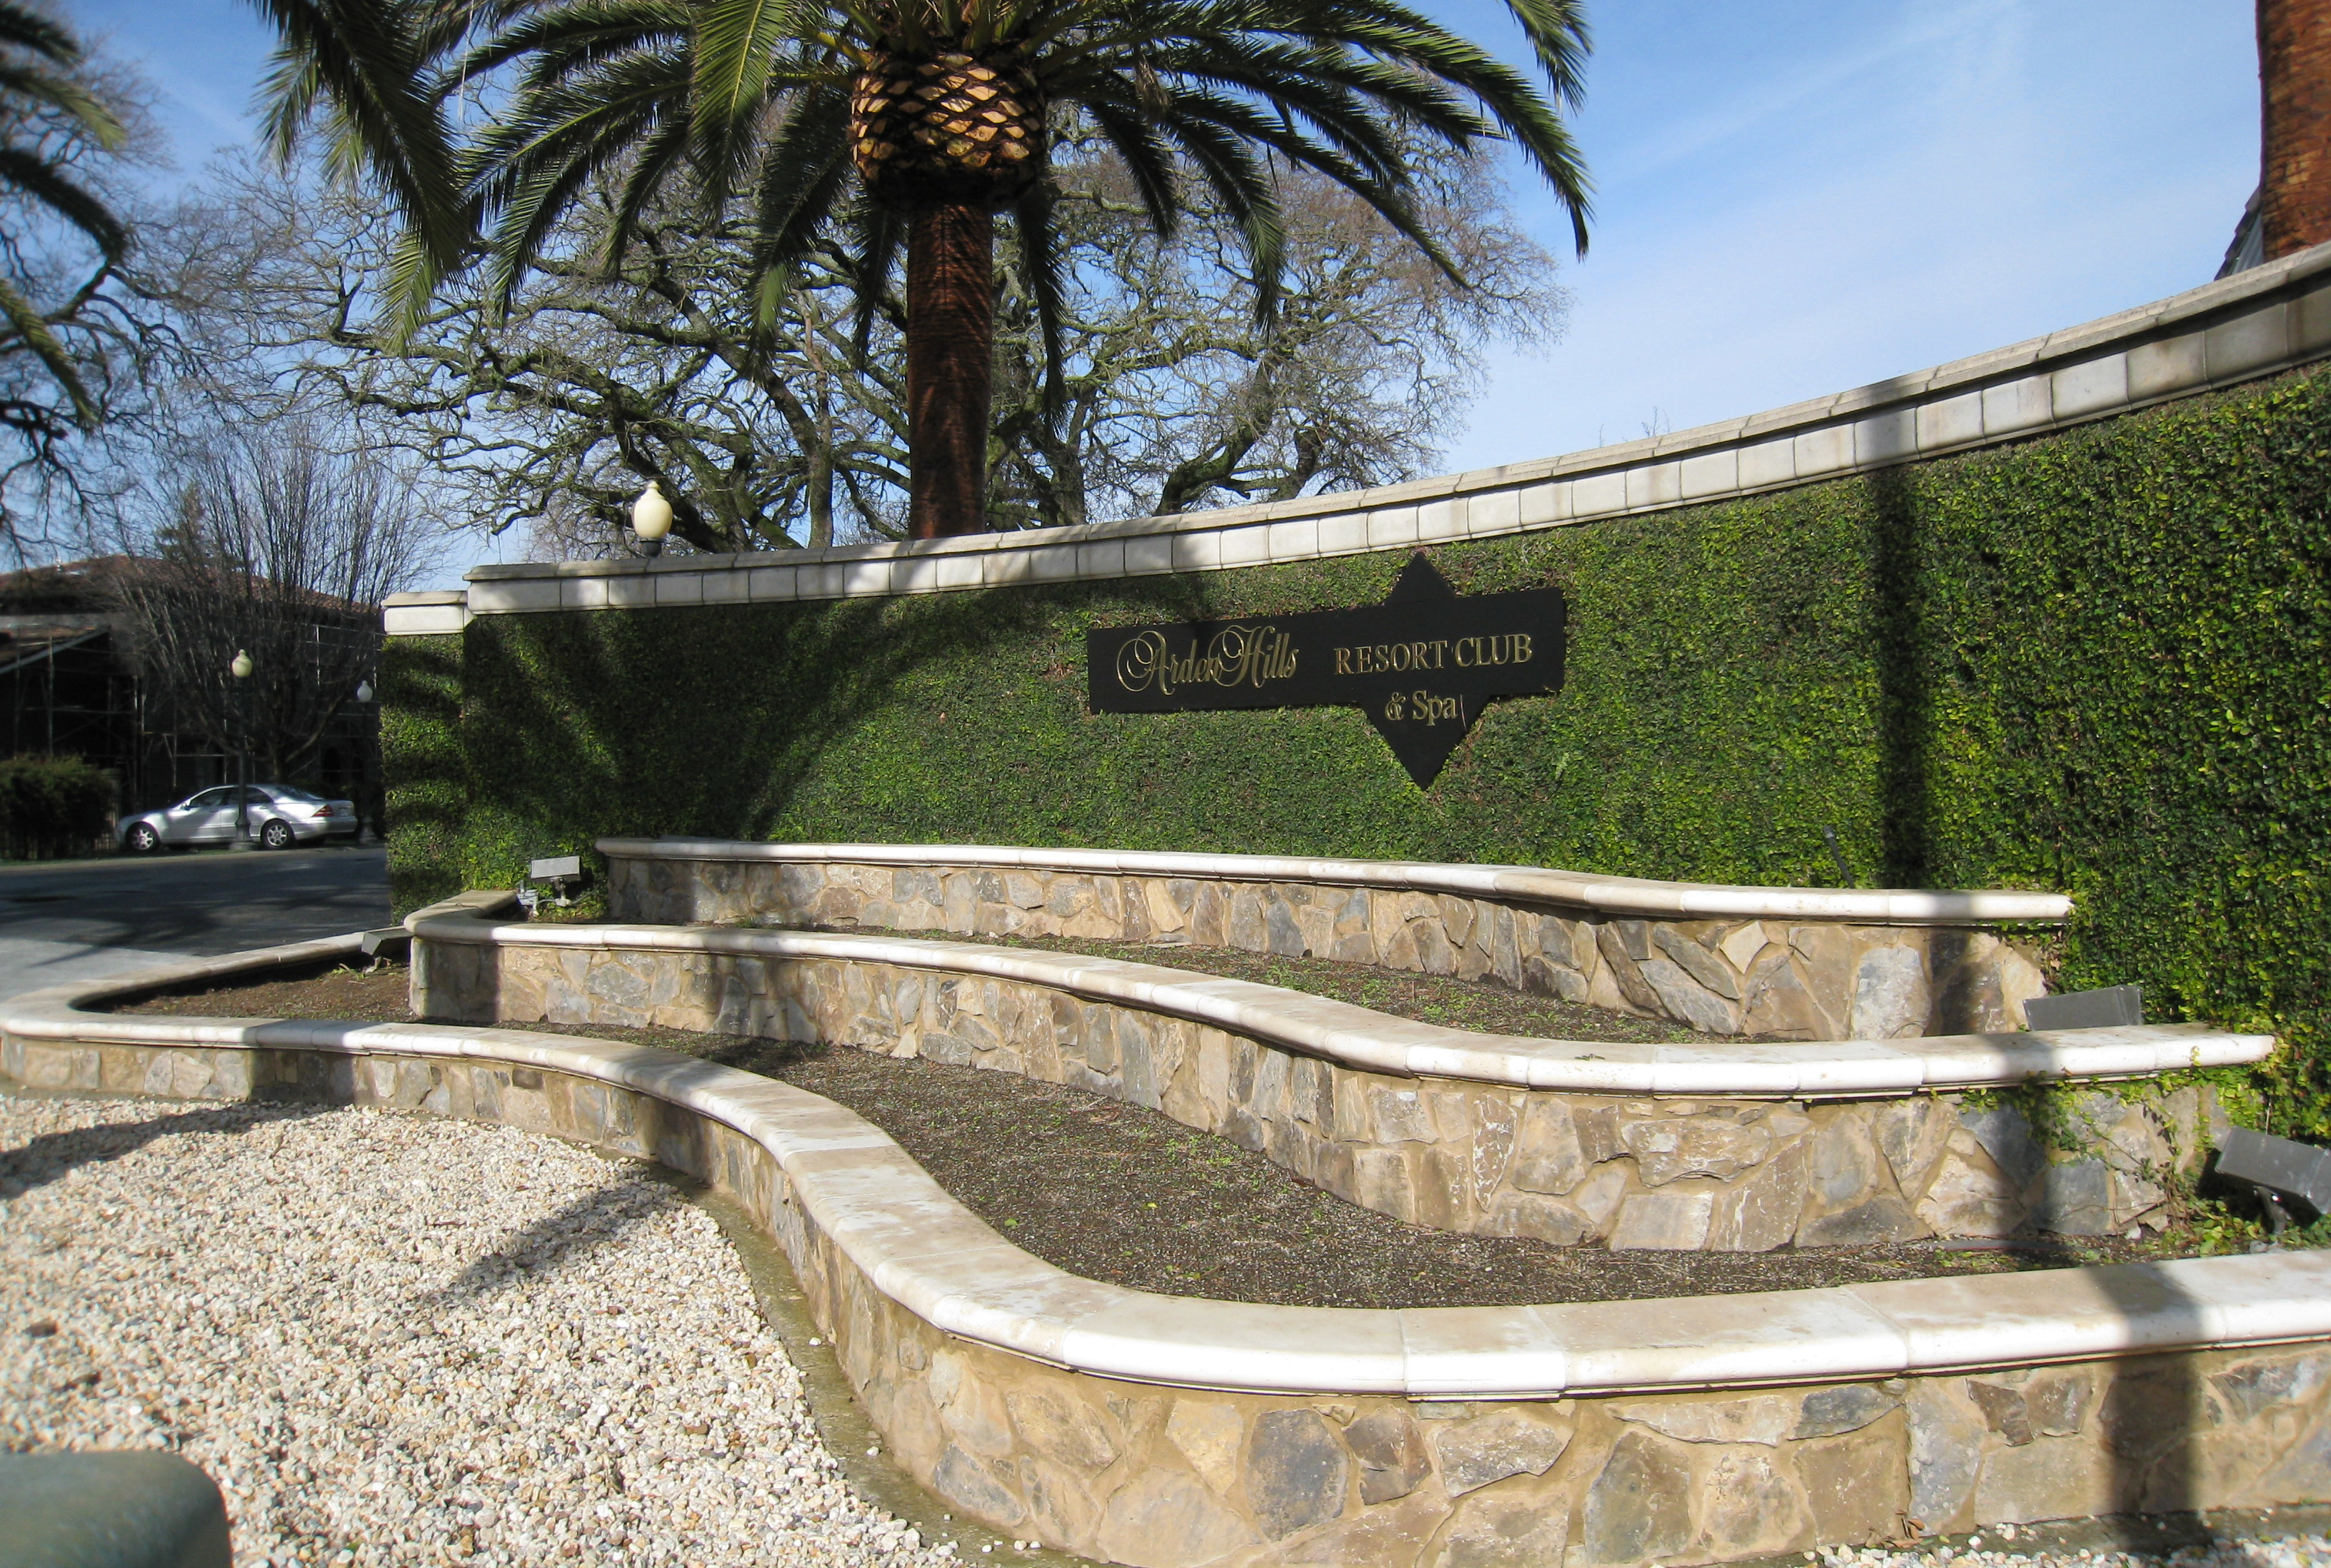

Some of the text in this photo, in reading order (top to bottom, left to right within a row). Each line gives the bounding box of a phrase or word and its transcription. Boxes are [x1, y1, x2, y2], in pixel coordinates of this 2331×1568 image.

[1116, 625, 1300, 695] Arden Hills
[1333, 633, 1533, 675] RESORT CLUB
[1385, 690, 1457, 726] & Spa
